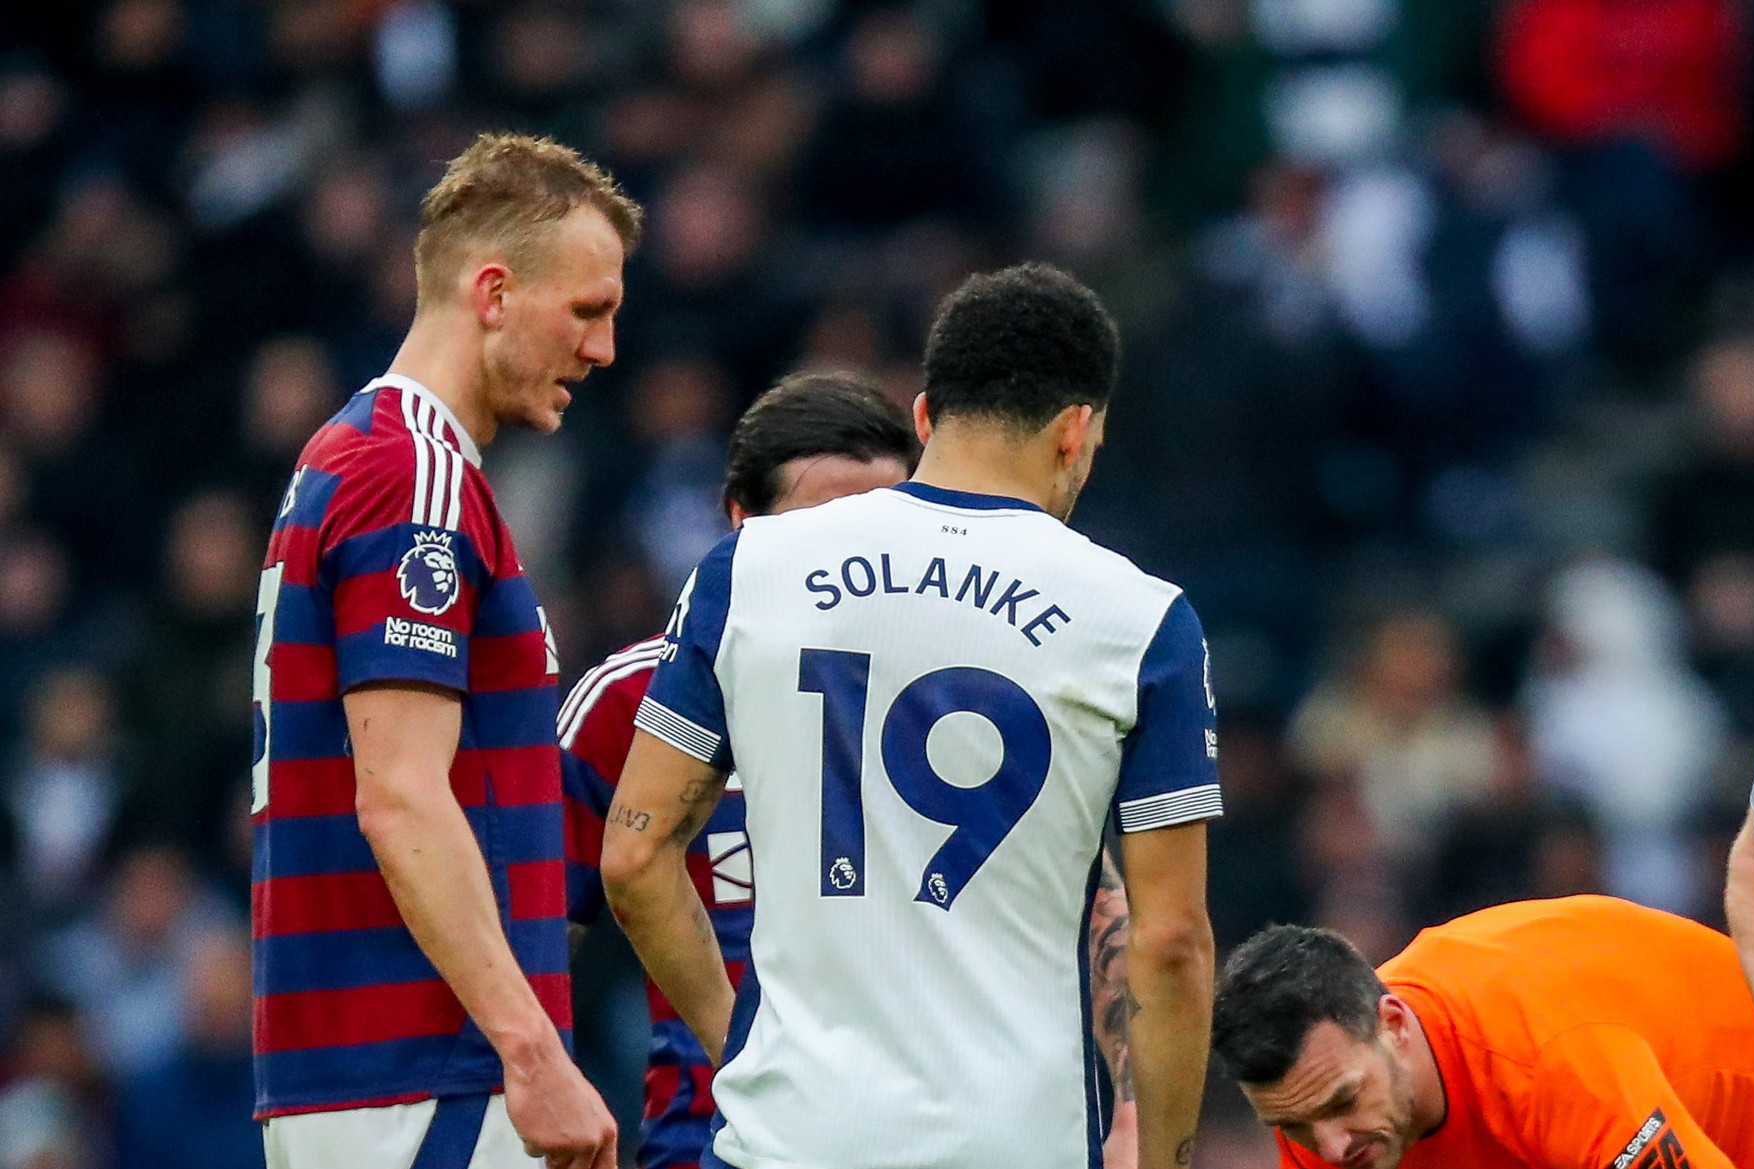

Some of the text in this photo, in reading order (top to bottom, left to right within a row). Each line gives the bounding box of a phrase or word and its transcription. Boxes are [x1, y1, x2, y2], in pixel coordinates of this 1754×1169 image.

[805, 553, 1072, 647] SOLANKE
[384, 631, 457, 658] for racism
[385, 616, 453, 643] No room
[797, 647, 1053, 912] 19
[1626, 1116, 1662, 1156] SPORTS
